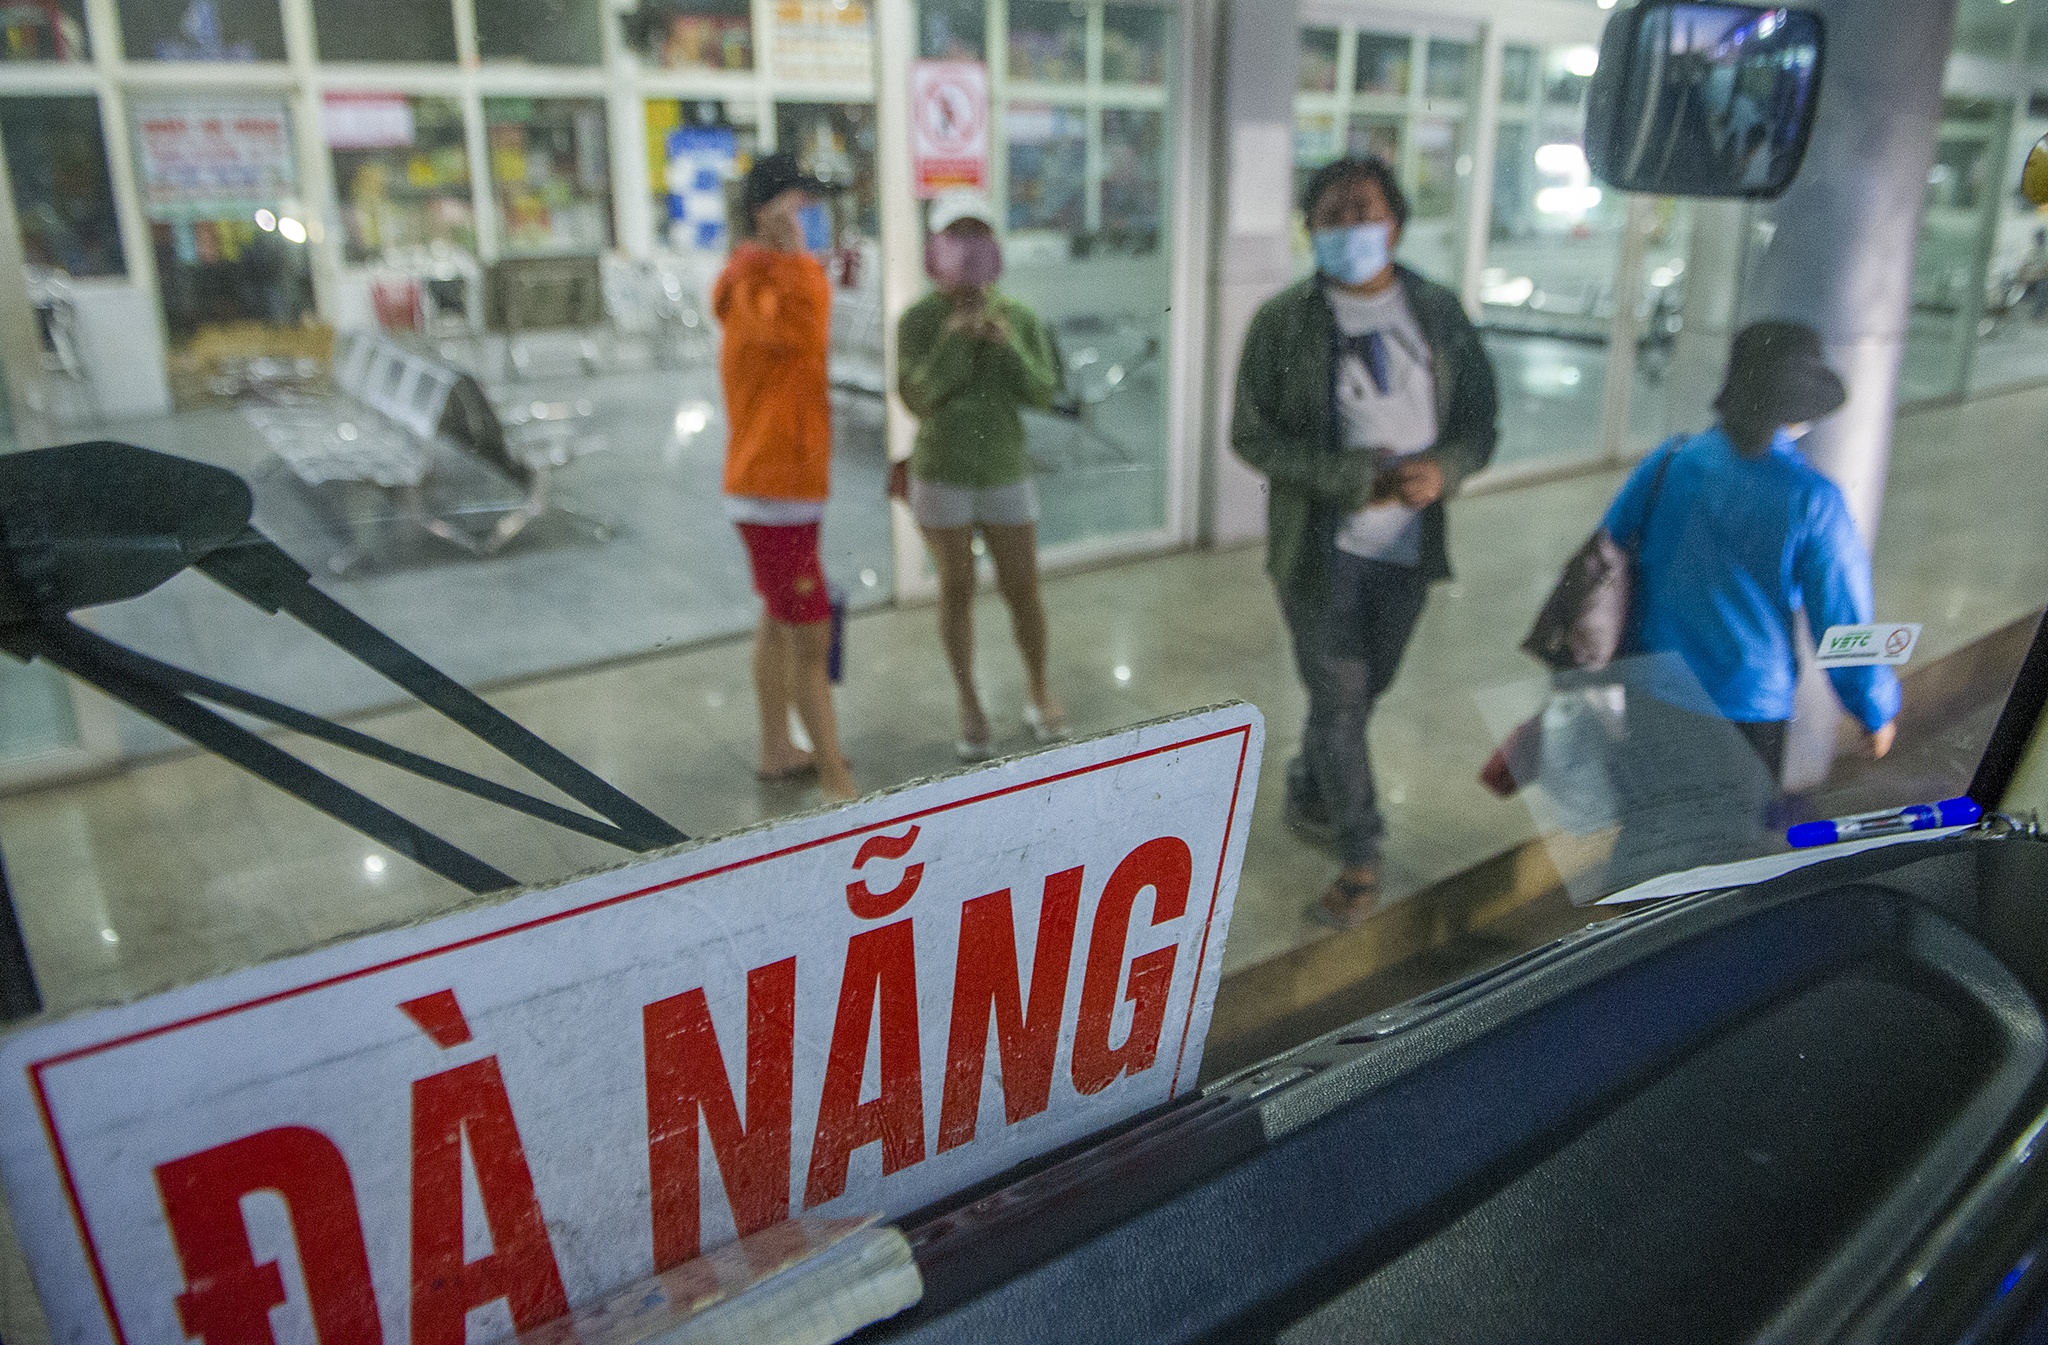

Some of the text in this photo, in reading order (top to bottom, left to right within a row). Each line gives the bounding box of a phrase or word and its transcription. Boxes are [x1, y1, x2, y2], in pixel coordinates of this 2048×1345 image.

[1832, 635, 1872, 649] VETC
[155, 825, 1193, 1345] ĐÀ NẴNG
